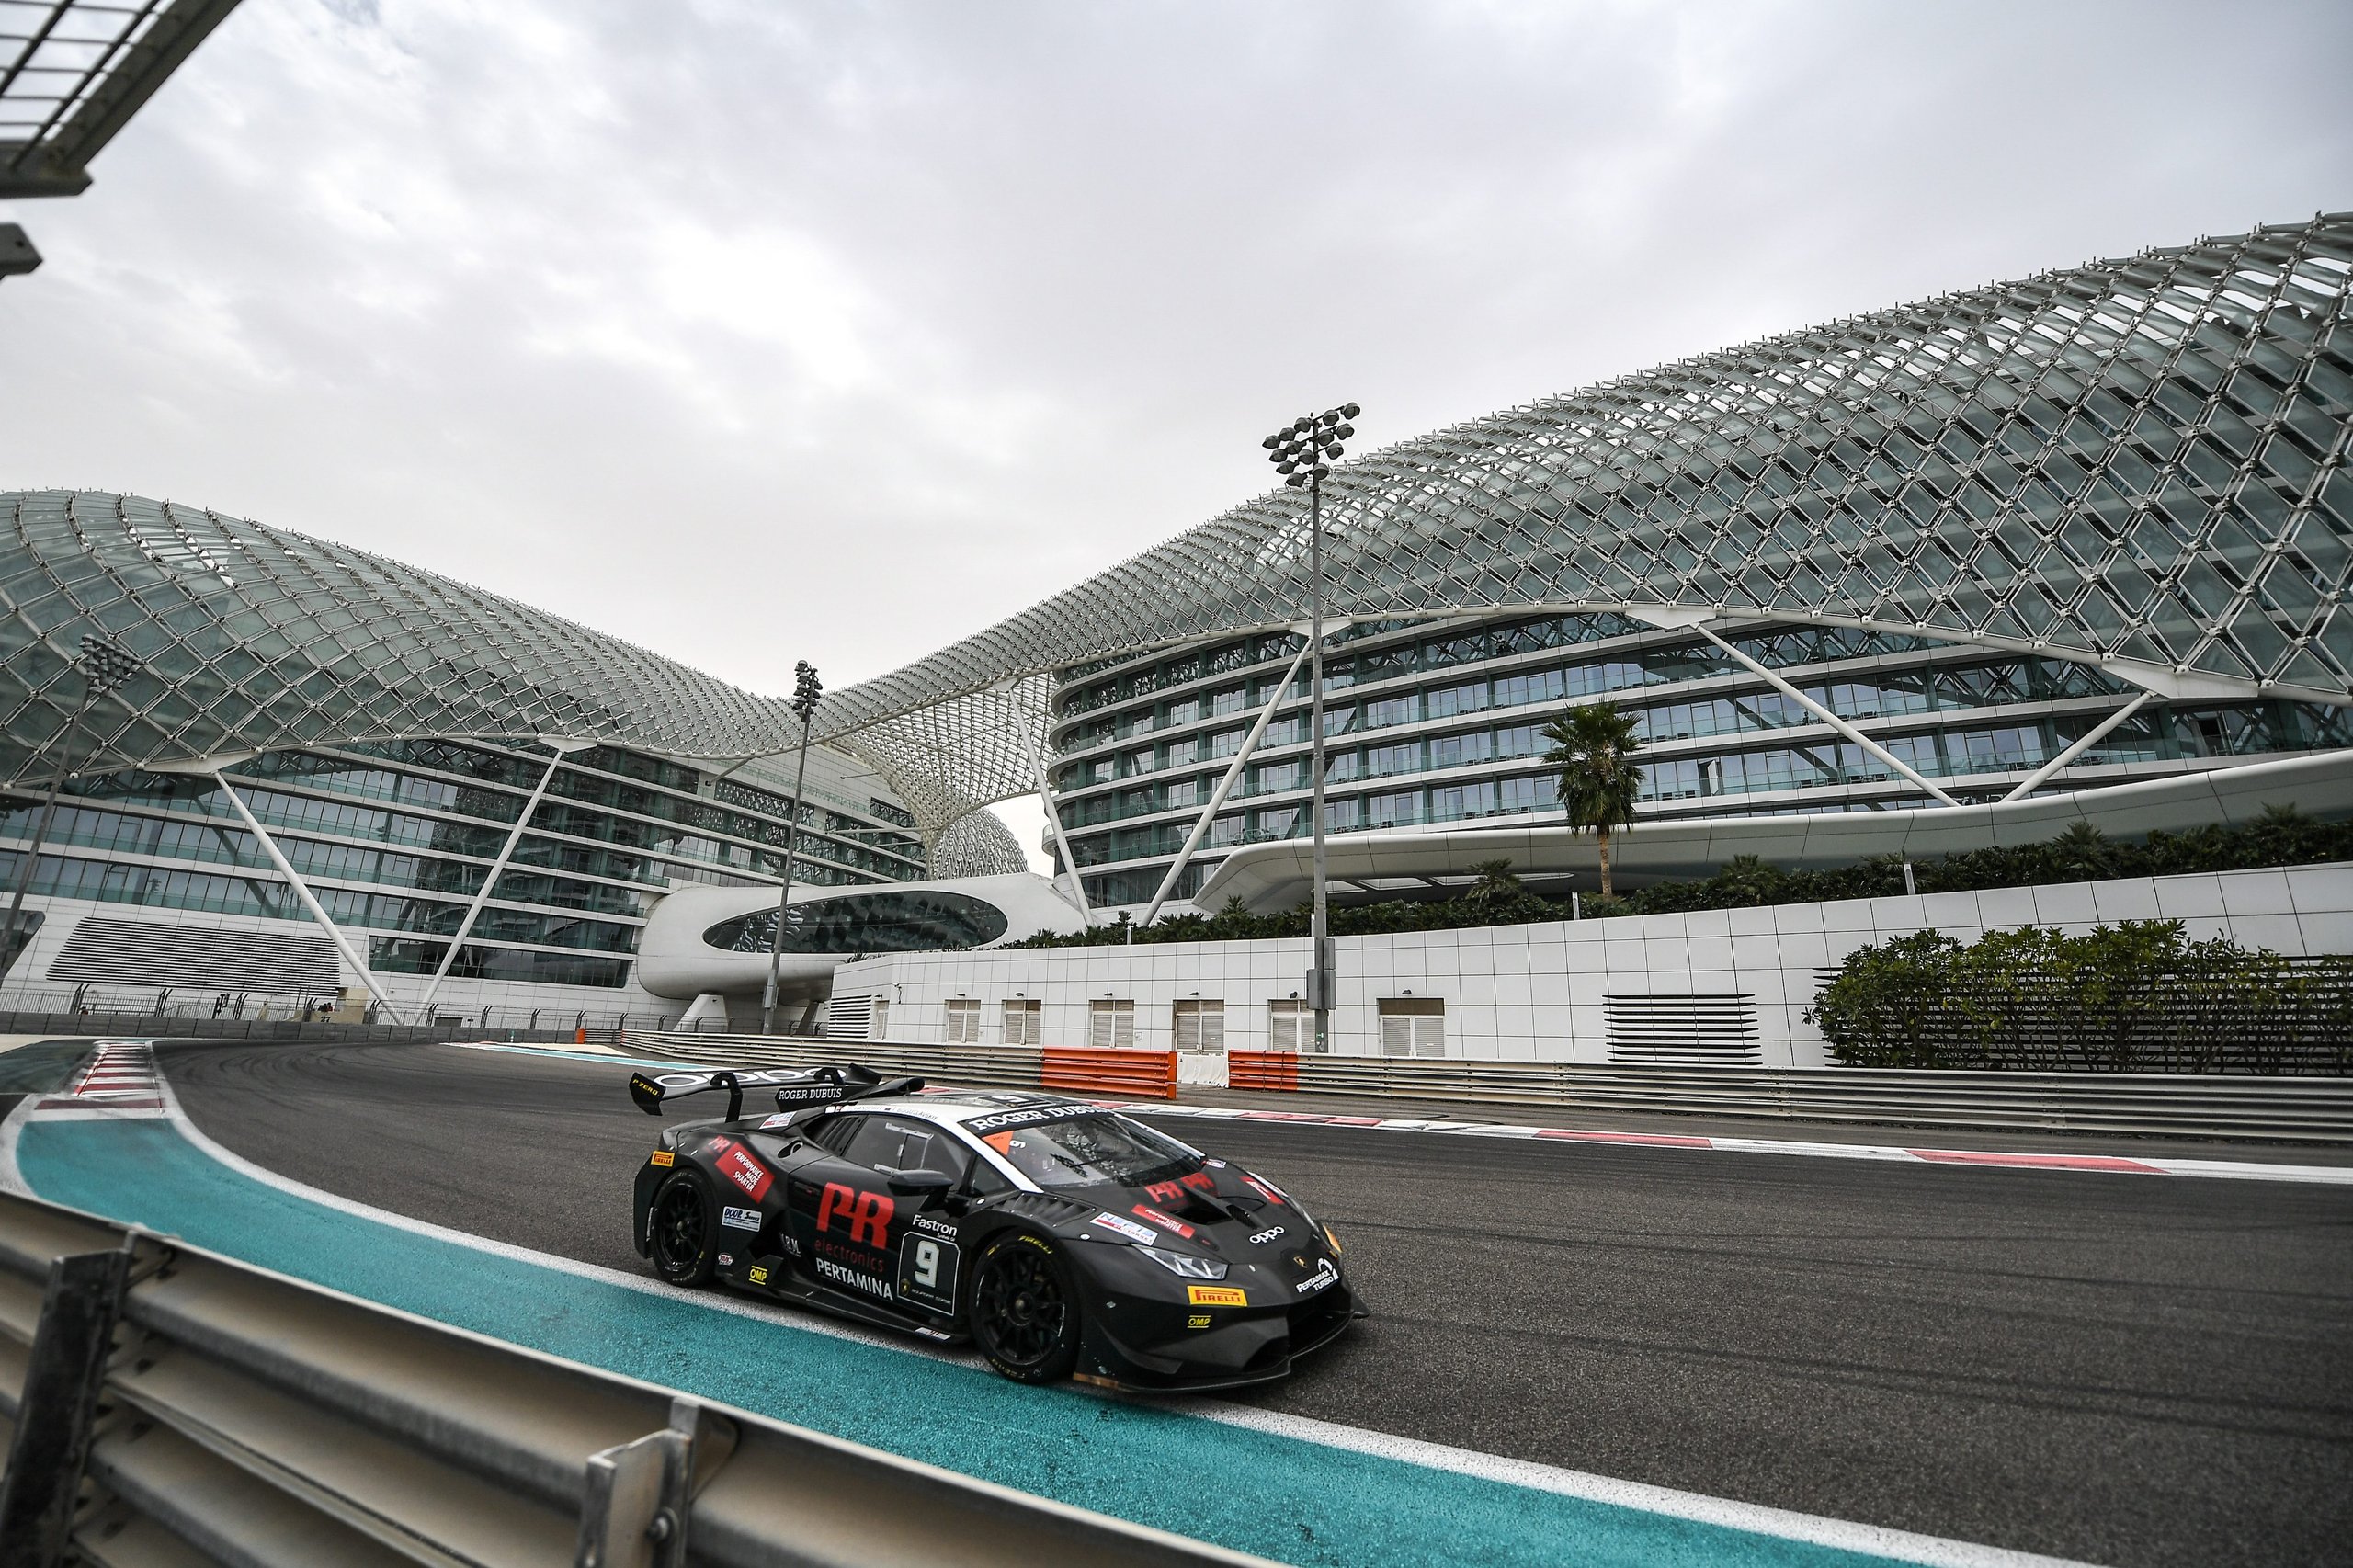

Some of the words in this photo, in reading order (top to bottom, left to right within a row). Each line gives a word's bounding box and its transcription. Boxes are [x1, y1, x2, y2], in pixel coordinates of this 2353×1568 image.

[779, 1089, 808, 1101] ROGER
[809, 1087, 843, 1099] DUBUIS
[969, 1110, 1051, 1131] ROGER
[733, 1151, 765, 1179] PERFORMANCE
[733, 1170, 755, 1192] SMARTER
[745, 1170, 760, 1186] MADE
[816, 1182, 895, 1251] PR
[912, 1213, 958, 1237] Fastron
[1249, 1225, 1285, 1244] oppo
[814, 1237, 884, 1273] electronics
[914, 1240, 940, 1288] 9
[749, 1268, 768, 1282] OMP
[816, 1257, 893, 1301] PERTAMINA
[1296, 1269, 1331, 1294] PERTAMAX
[1313, 1276, 1334, 1292] TURBO
[1195, 1290, 1242, 1303] PIRELLI
[1188, 1317, 1211, 1326] OMP
